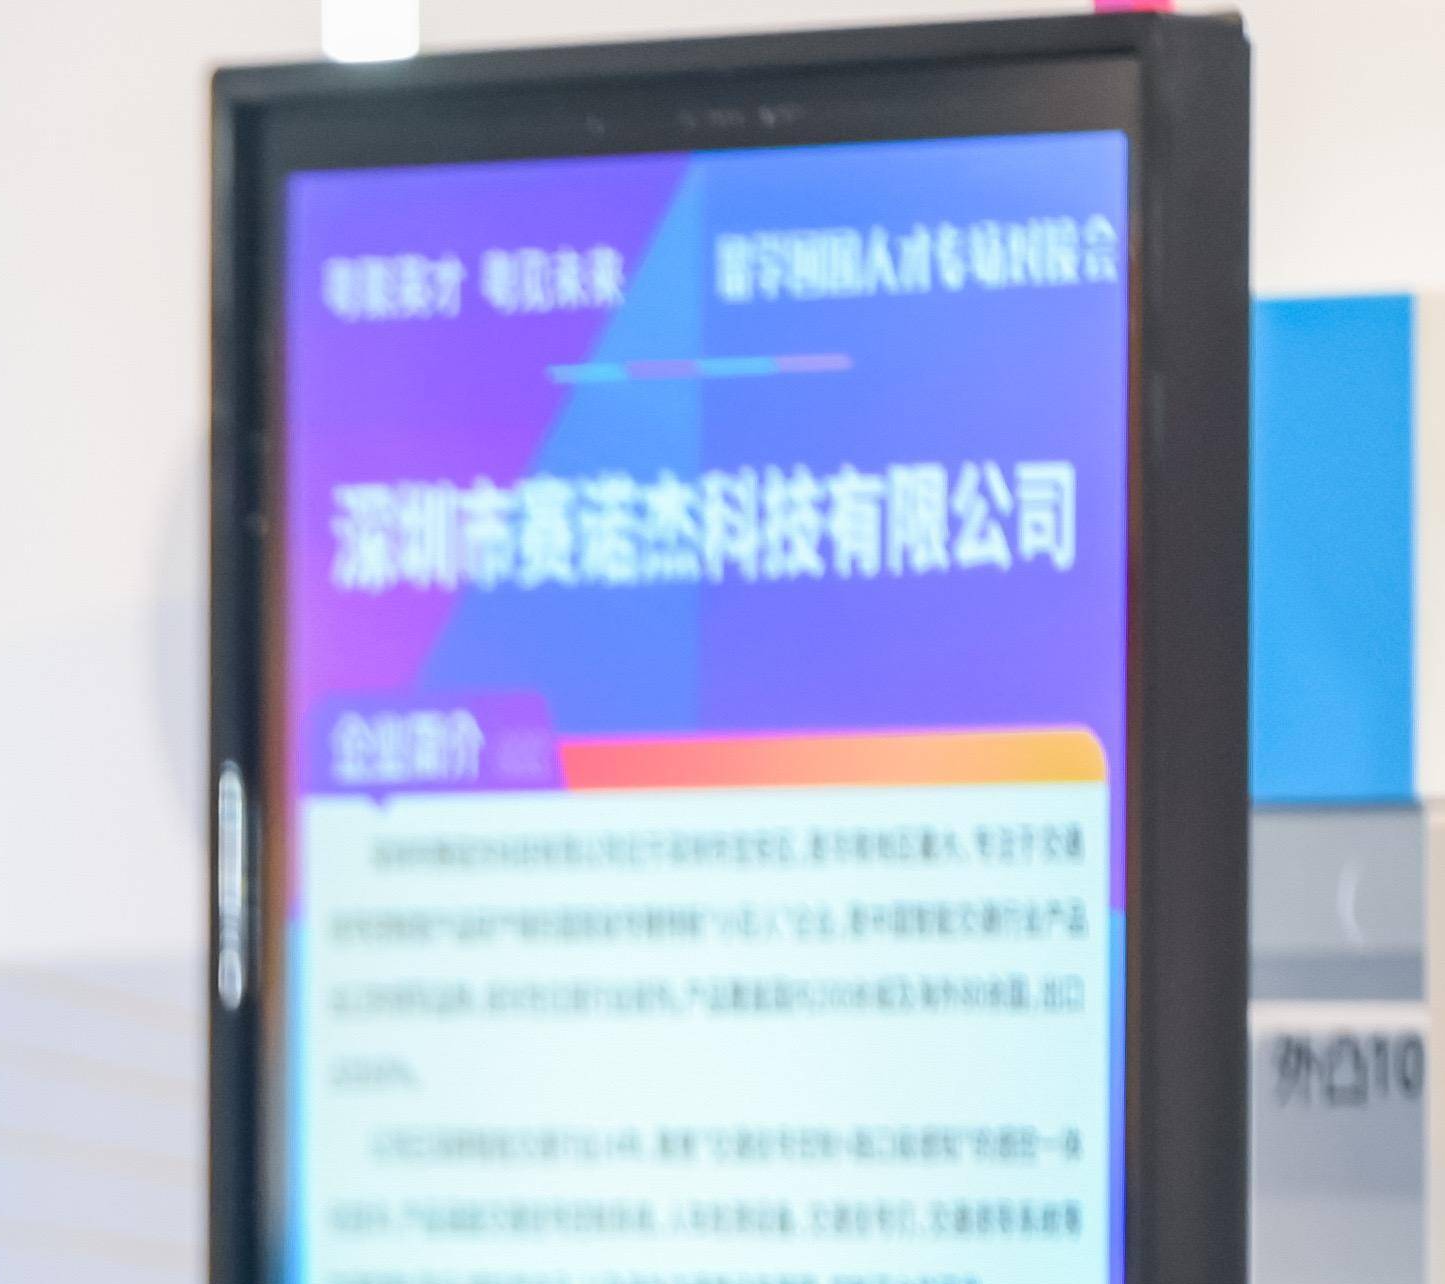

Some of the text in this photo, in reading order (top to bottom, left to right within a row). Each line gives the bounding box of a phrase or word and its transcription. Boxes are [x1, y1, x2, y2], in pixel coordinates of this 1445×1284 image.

[329, 461, 1077, 592] 深圳市赛诺杰科技有限公司
[330, 707, 485, 785] 企业简介
